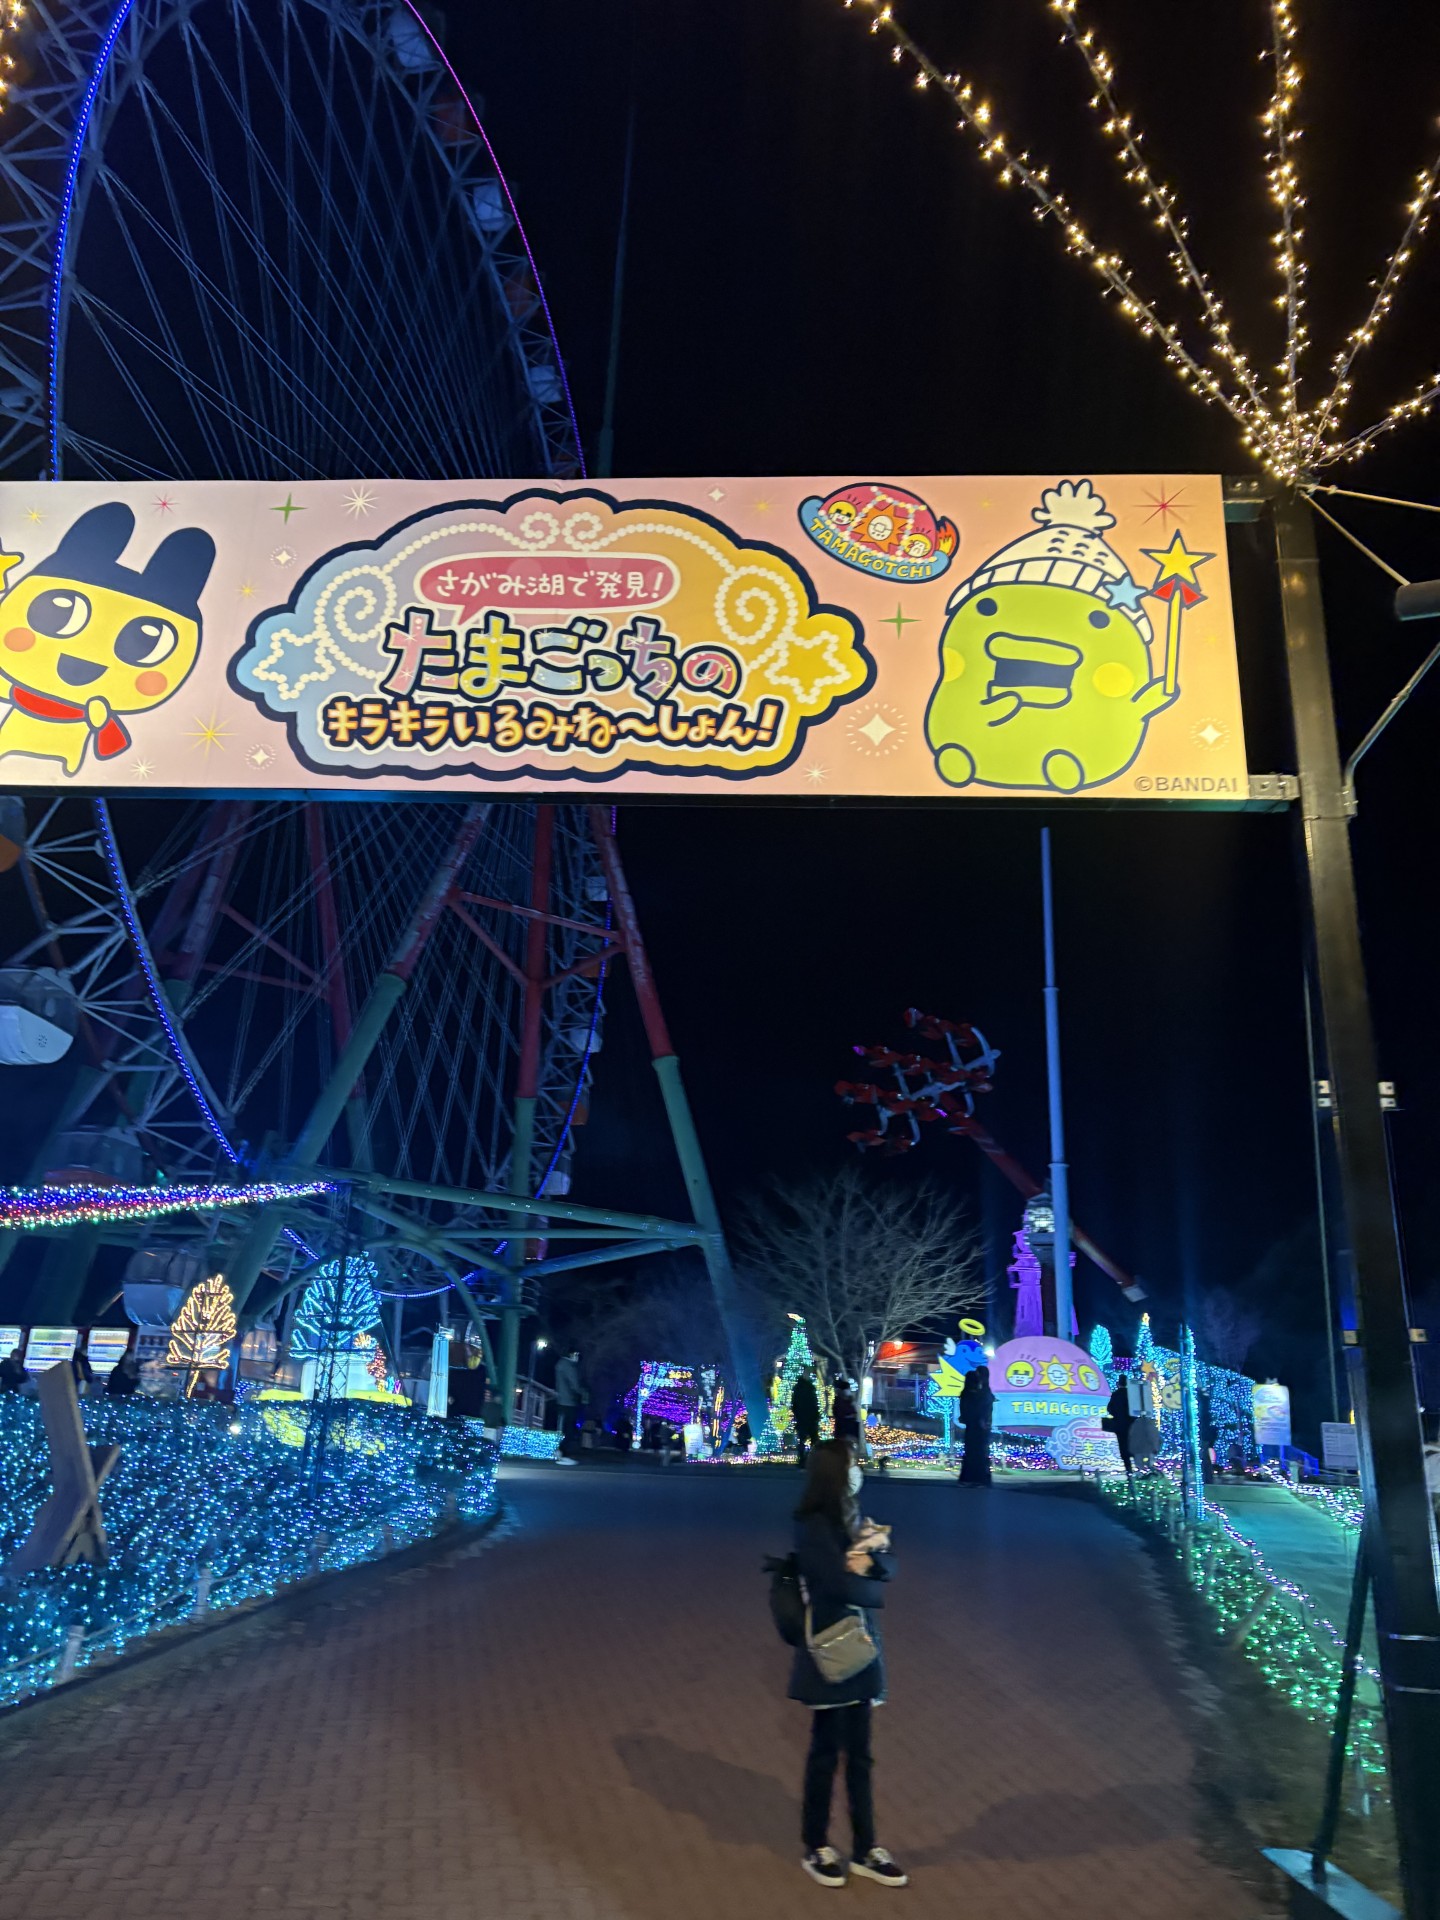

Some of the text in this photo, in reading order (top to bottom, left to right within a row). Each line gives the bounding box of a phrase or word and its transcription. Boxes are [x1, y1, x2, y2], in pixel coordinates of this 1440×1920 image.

[809, 517, 932, 578] TAMAGOTCHI
[436, 569, 664, 598] さがみ湖で発見!
[385, 611, 743, 699] たまごっちの
[1134, 775, 1238, 793] ©BANDAI
[1010, 1400, 1108, 1416] TAMAGOTCH
